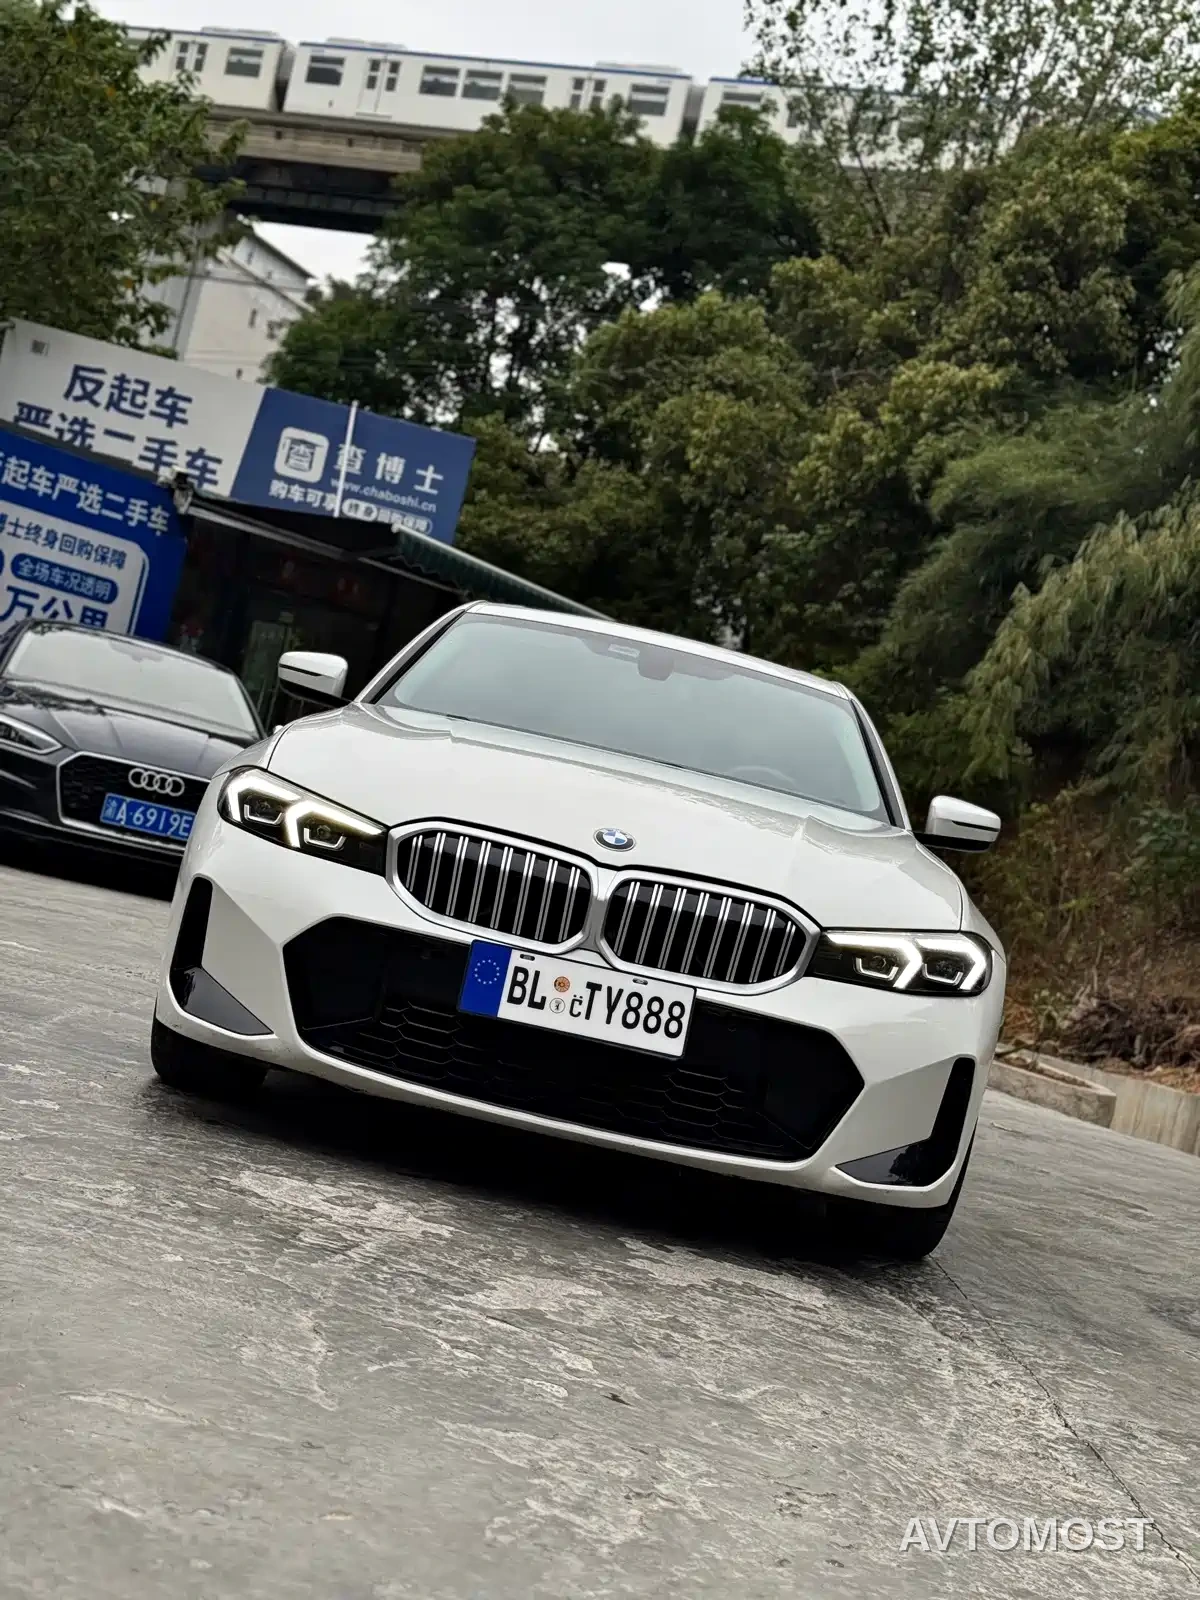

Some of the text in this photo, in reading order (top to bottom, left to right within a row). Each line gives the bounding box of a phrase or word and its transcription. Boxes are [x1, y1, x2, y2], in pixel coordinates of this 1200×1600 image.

[64, 364, 193, 428] 反起车
[0, 452, 170, 536] 起车严选二手车
[507, 966, 547, 1010] BL
